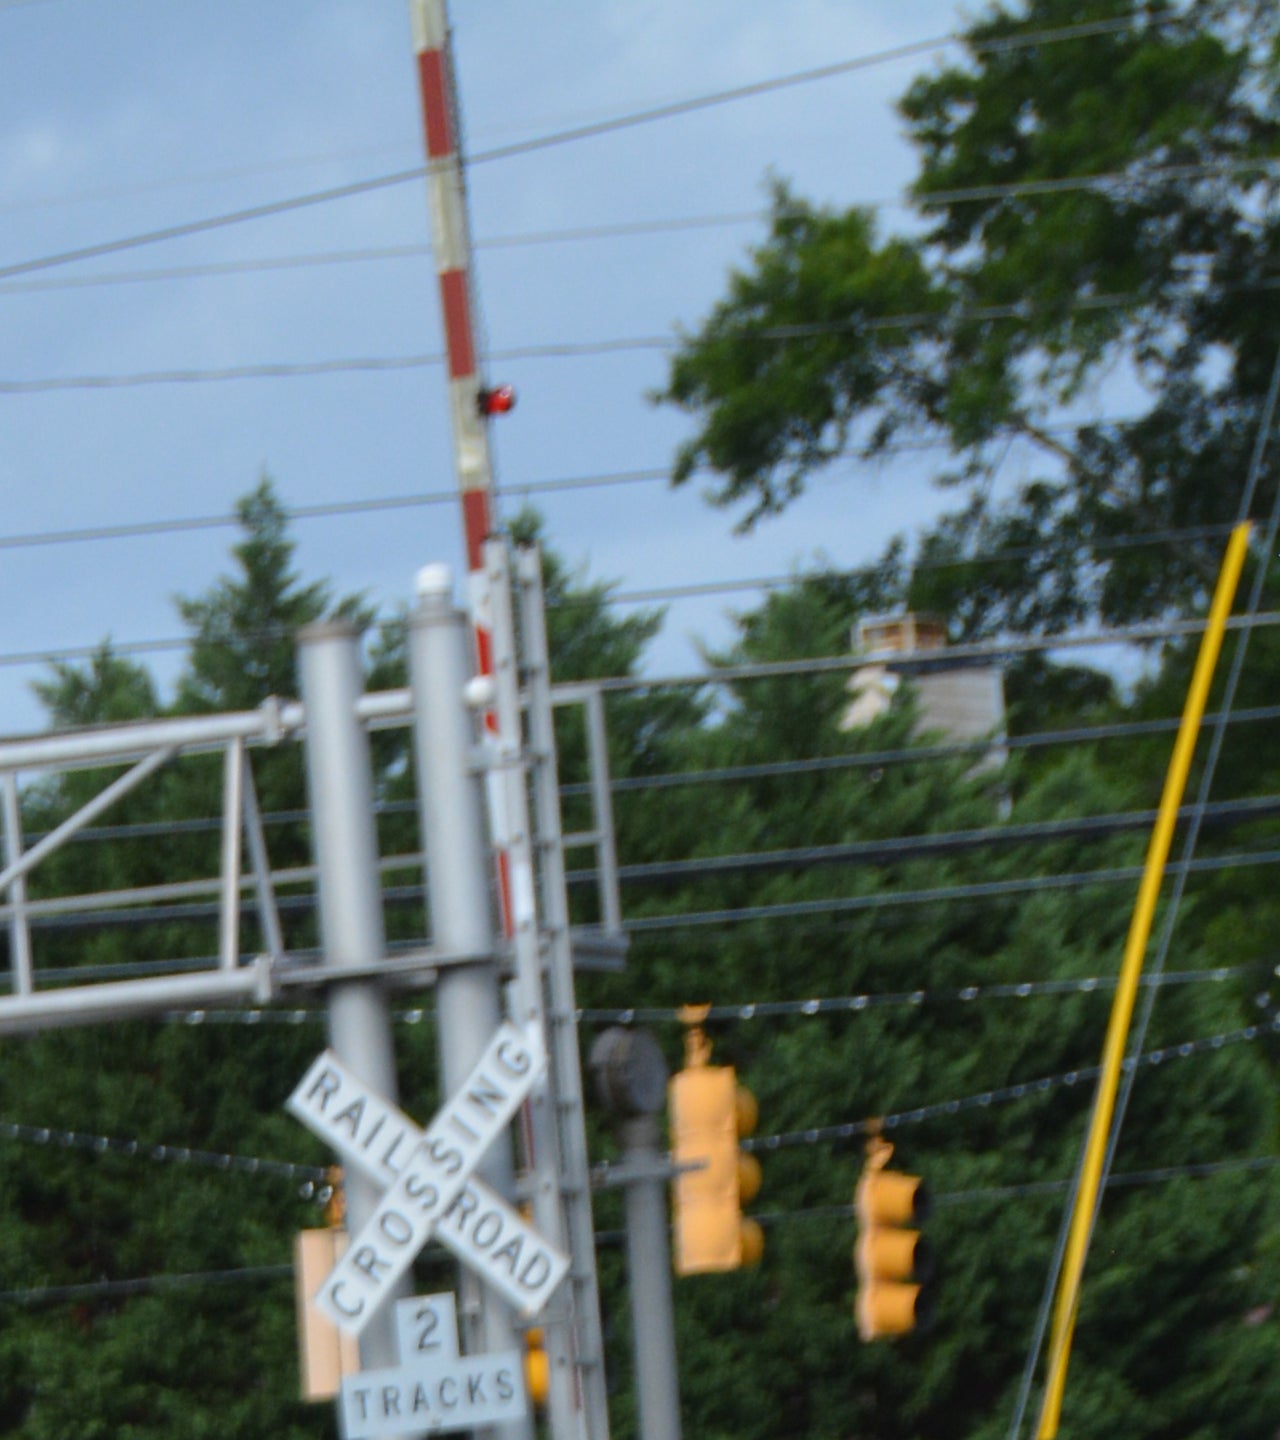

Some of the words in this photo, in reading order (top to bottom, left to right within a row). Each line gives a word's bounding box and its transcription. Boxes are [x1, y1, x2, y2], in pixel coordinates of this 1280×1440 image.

[330, 1037, 532, 1318] CROSSING
[415, 1307, 443, 1351] 2
[353, 1368, 515, 1420] TRACKS
